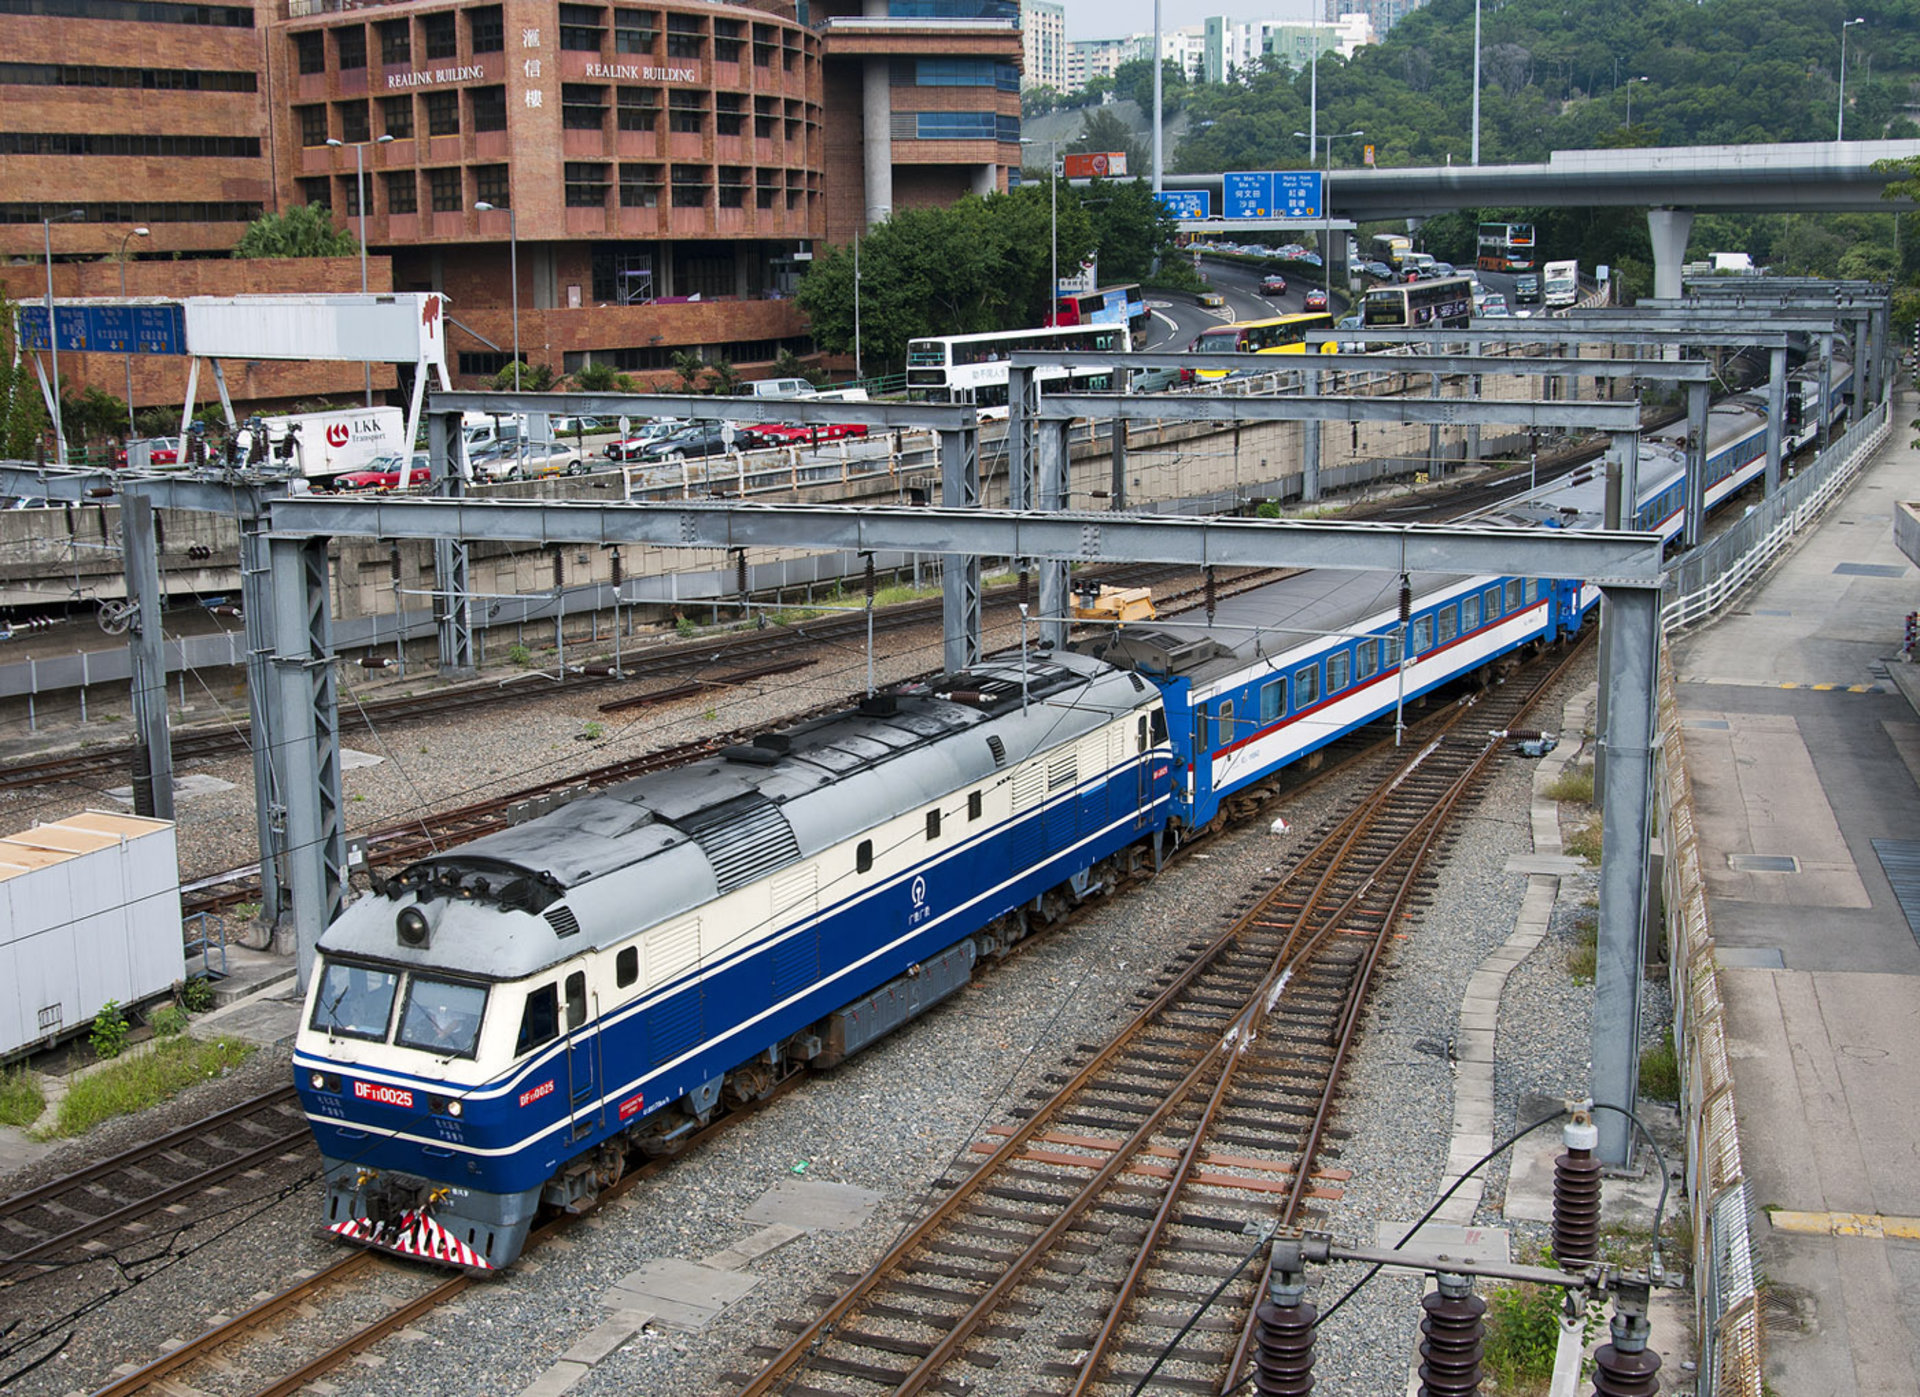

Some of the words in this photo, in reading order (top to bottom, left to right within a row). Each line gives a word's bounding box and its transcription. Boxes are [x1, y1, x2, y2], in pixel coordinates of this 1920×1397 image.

[388, 70, 433, 88] REALINK
[436, 65, 484, 84] BUILDING
[585, 63, 639, 79] REALINK
[642, 66, 695, 82] BUILDING
[354, 418, 383, 433] LKK
[352, 433, 387, 443] Transport
